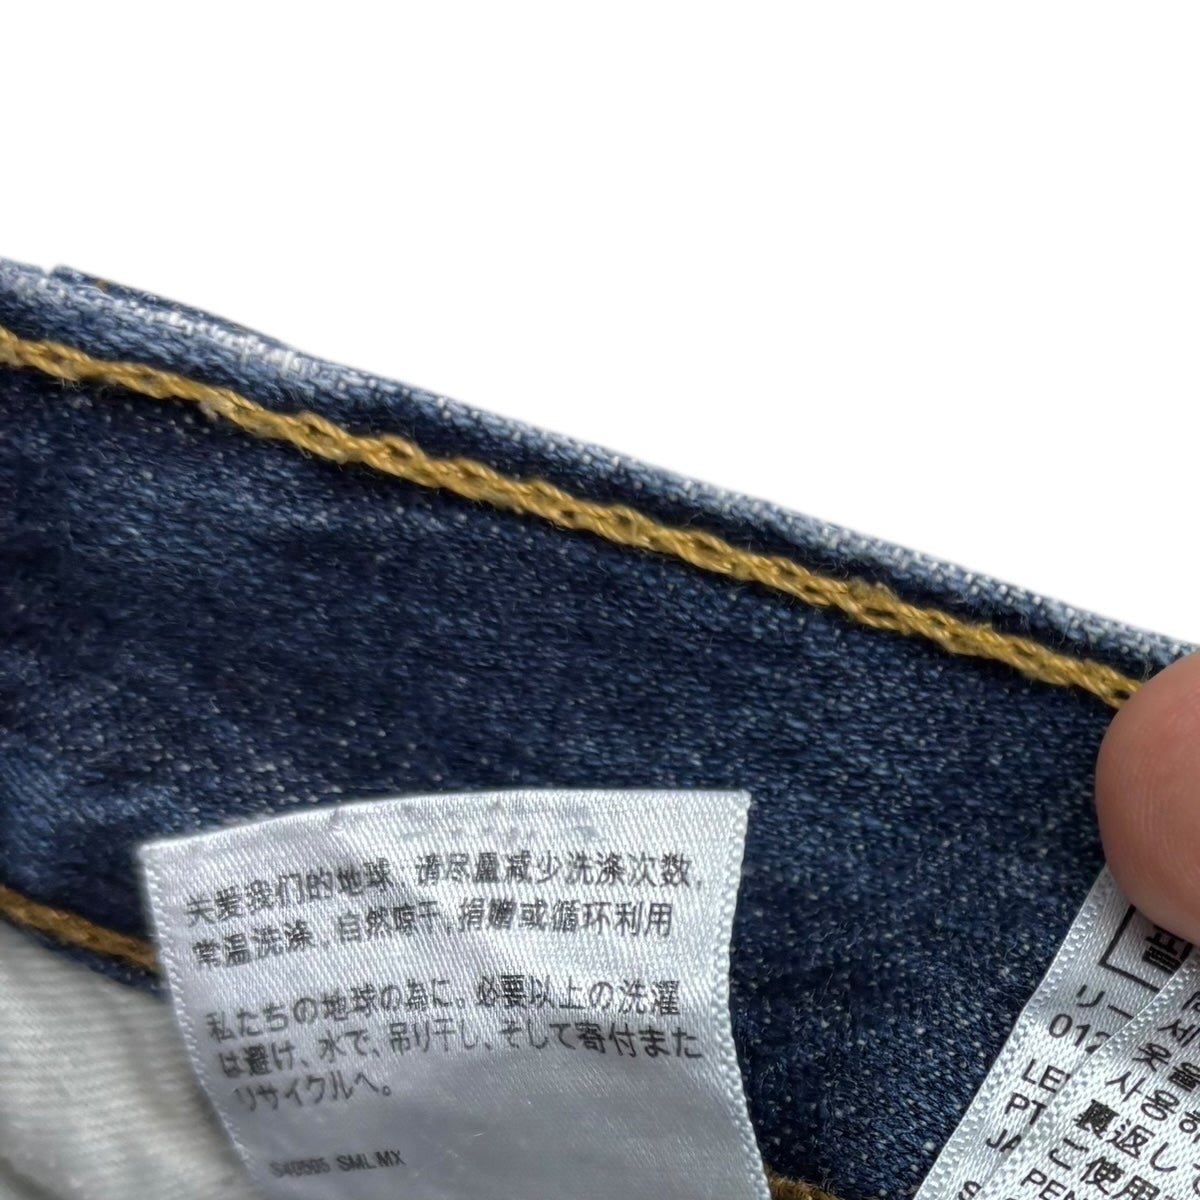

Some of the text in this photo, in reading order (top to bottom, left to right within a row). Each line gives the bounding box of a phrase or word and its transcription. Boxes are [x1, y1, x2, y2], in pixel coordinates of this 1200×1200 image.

[233, 1070, 392, 1112] リサイクルへ。
